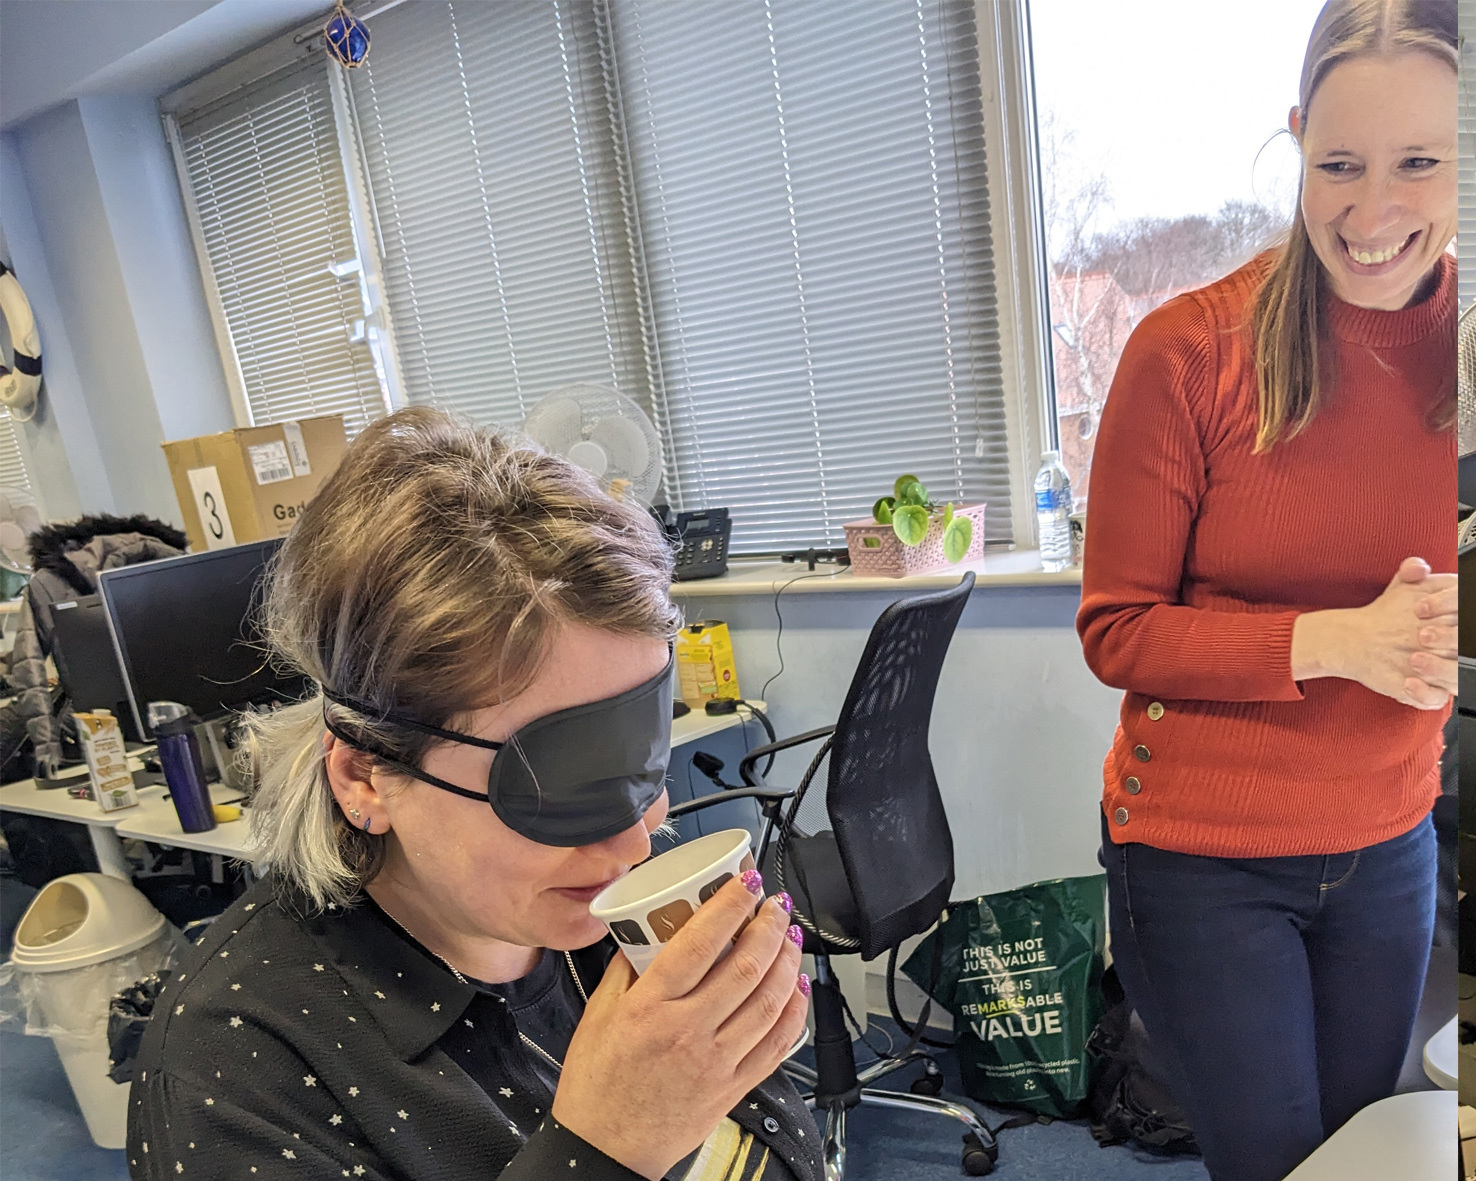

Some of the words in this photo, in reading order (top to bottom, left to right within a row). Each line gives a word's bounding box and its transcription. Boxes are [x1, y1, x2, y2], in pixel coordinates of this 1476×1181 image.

[203, 491, 224, 540] 3
[273, 501, 306, 521] Gad
[963, 946, 993, 960] THIS
[998, 943, 1012, 955] IS
[1015, 938, 1043, 952] NOT
[963, 958, 995, 972] JUST
[1001, 950, 1046, 967] VALUE
[982, 980, 1015, 995] THIS
[1020, 979, 1032, 991] IS
[961, 992, 1063, 1016] REMARKSABLE
[970, 1010, 1062, 1041] VALUE
